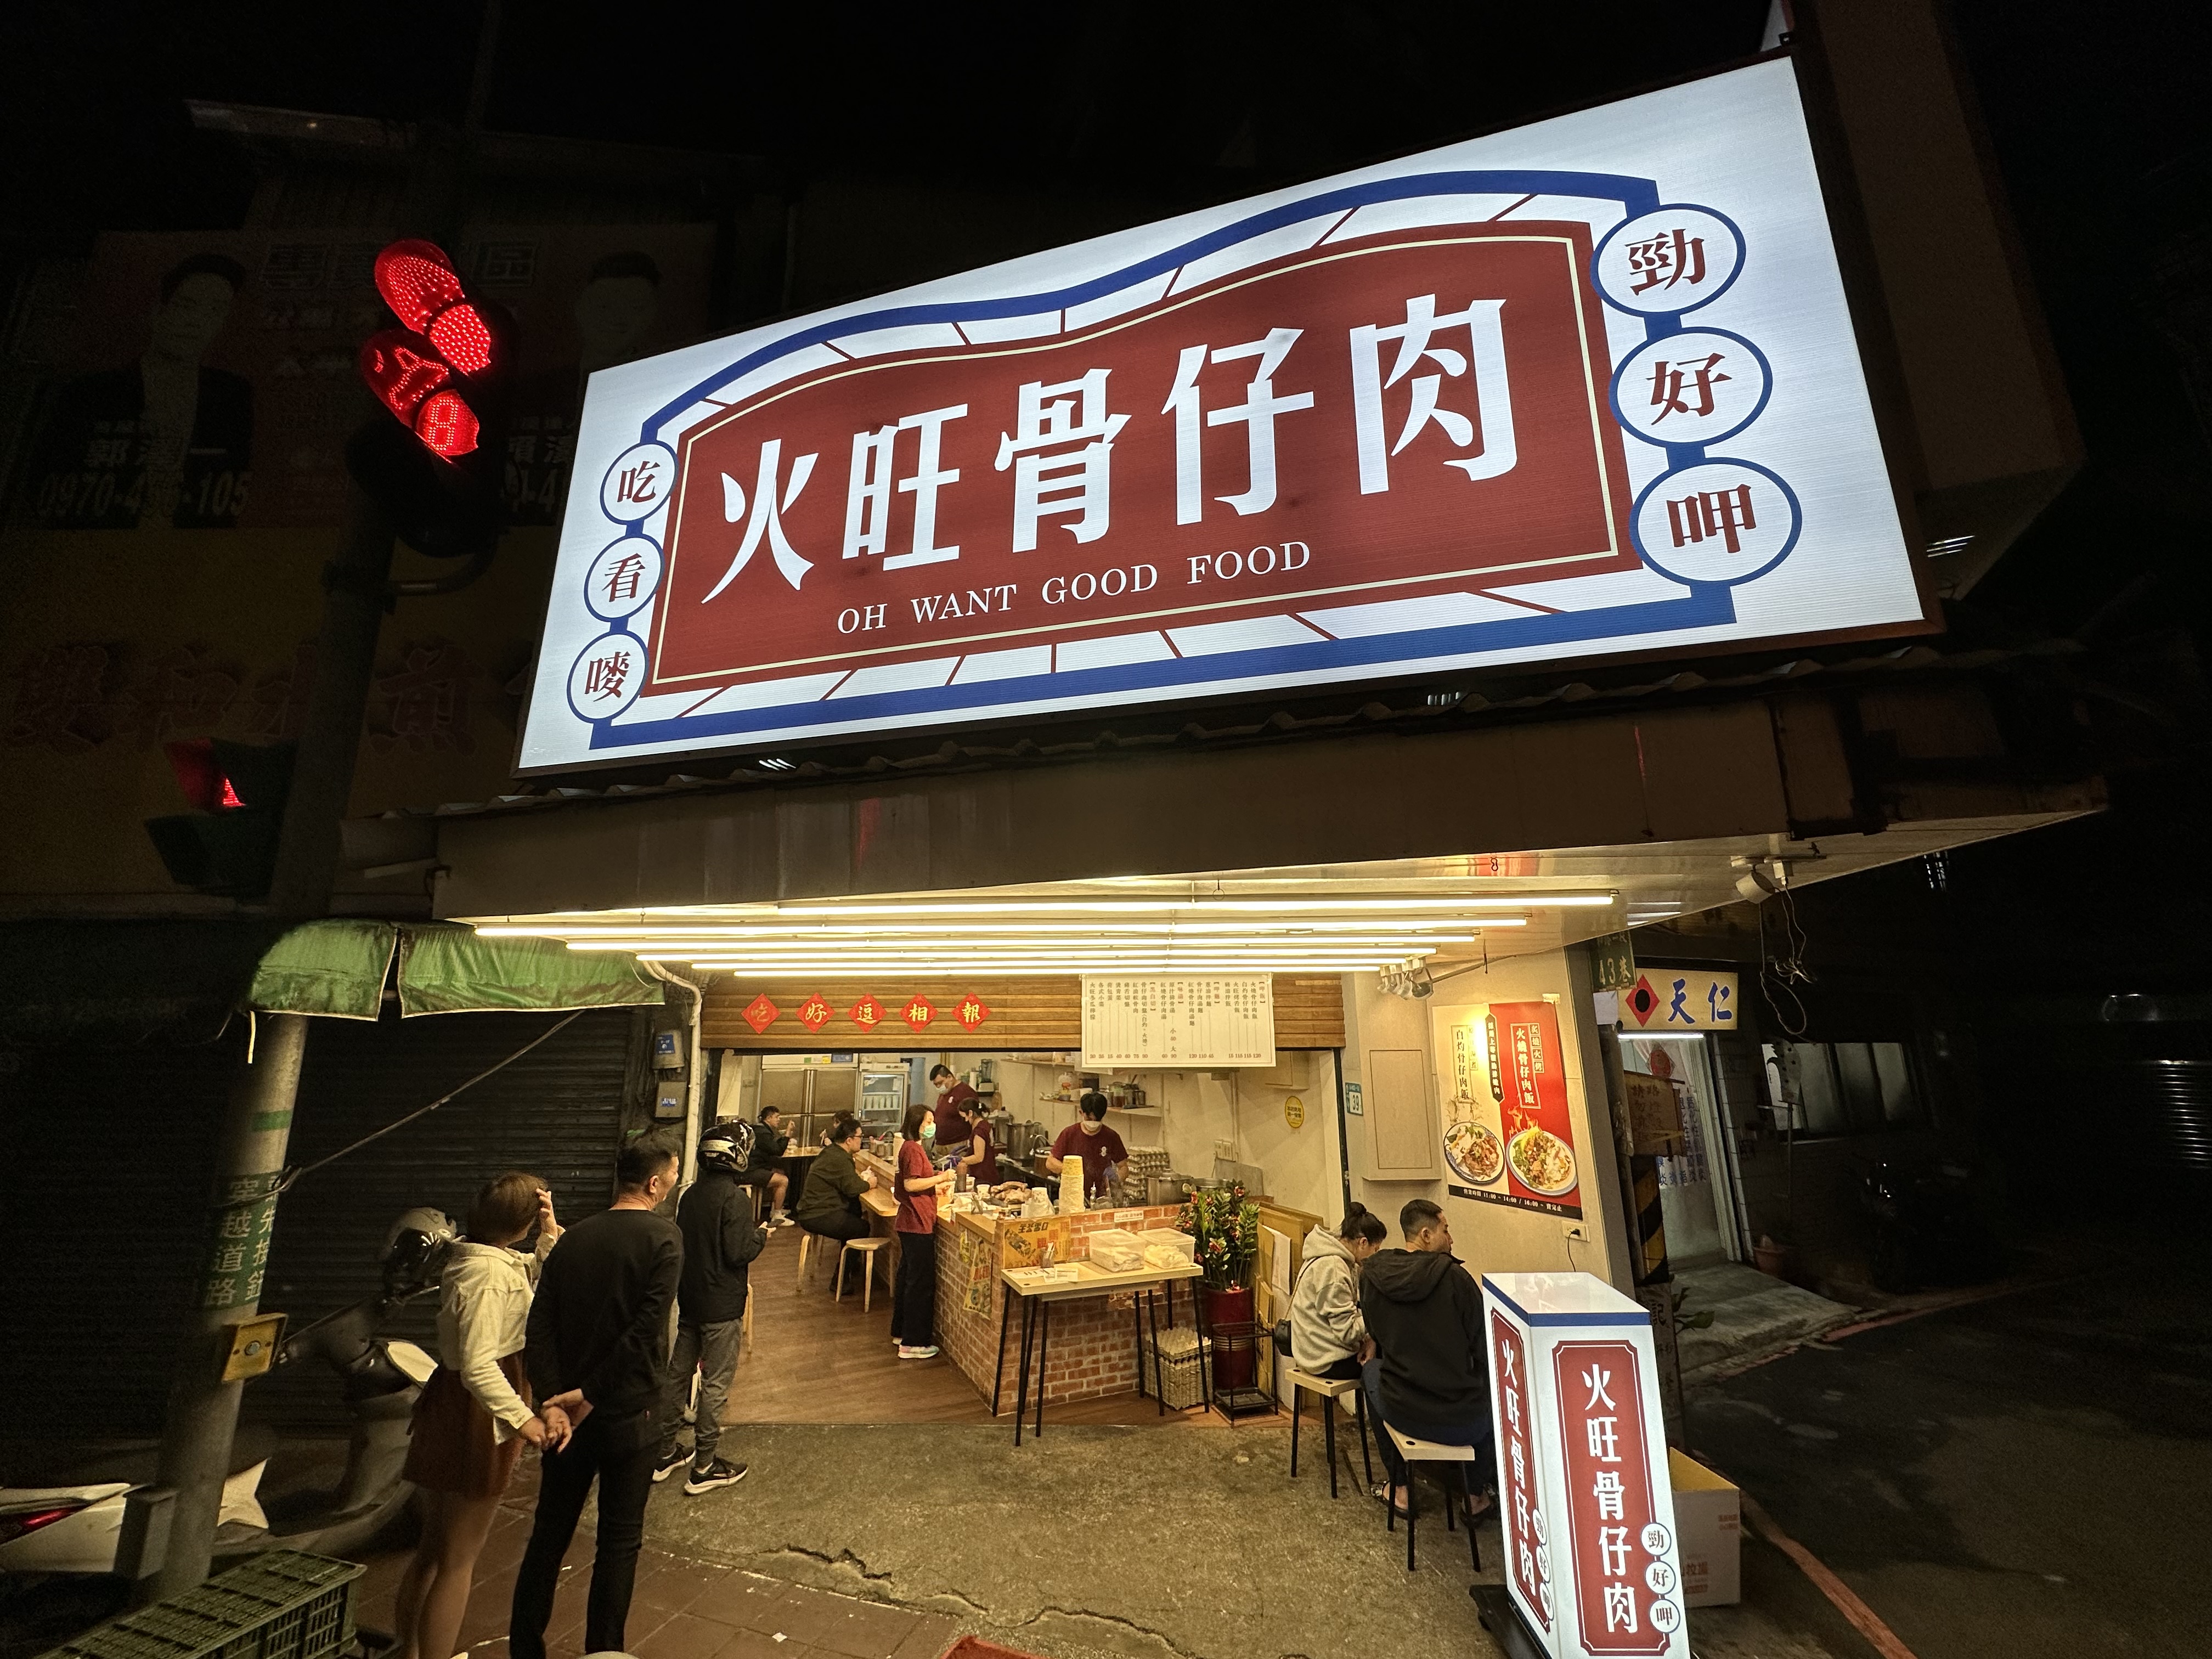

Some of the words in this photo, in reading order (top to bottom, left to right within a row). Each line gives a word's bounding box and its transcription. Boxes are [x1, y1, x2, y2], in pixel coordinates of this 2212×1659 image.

[1625, 229, 1756, 553] 勁好呷
[701, 294, 1520, 604] 火旺骨仔肉
[584, 461, 661, 702] 吃看嘜
[838, 603, 887, 633] OH
[911, 584, 1017, 623] WANT
[1042, 565, 1158, 604] GOOD
[1187, 541, 1310, 584] FOOD
[1599, 956, 1632, 985] 43巷
[1668, 978, 1733, 1025] 天仁
[751, 1002, 981, 1024] 吃好逗相報
[1352, 1094, 1359, 1111] 39
[1457, 1030, 1469, 1099] 白灼骨仔肉飯
[1516, 1028, 1534, 1104] 火燒骨仔肉飯
[1463, 1188, 1481, 1197] 營業時間
[1502, 1339, 1536, 1596] 火旺骨仔肉
[1582, 1364, 1638, 1633] 火旺骨仔肉
[1647, 1530, 1673, 1627] 勁好呷
